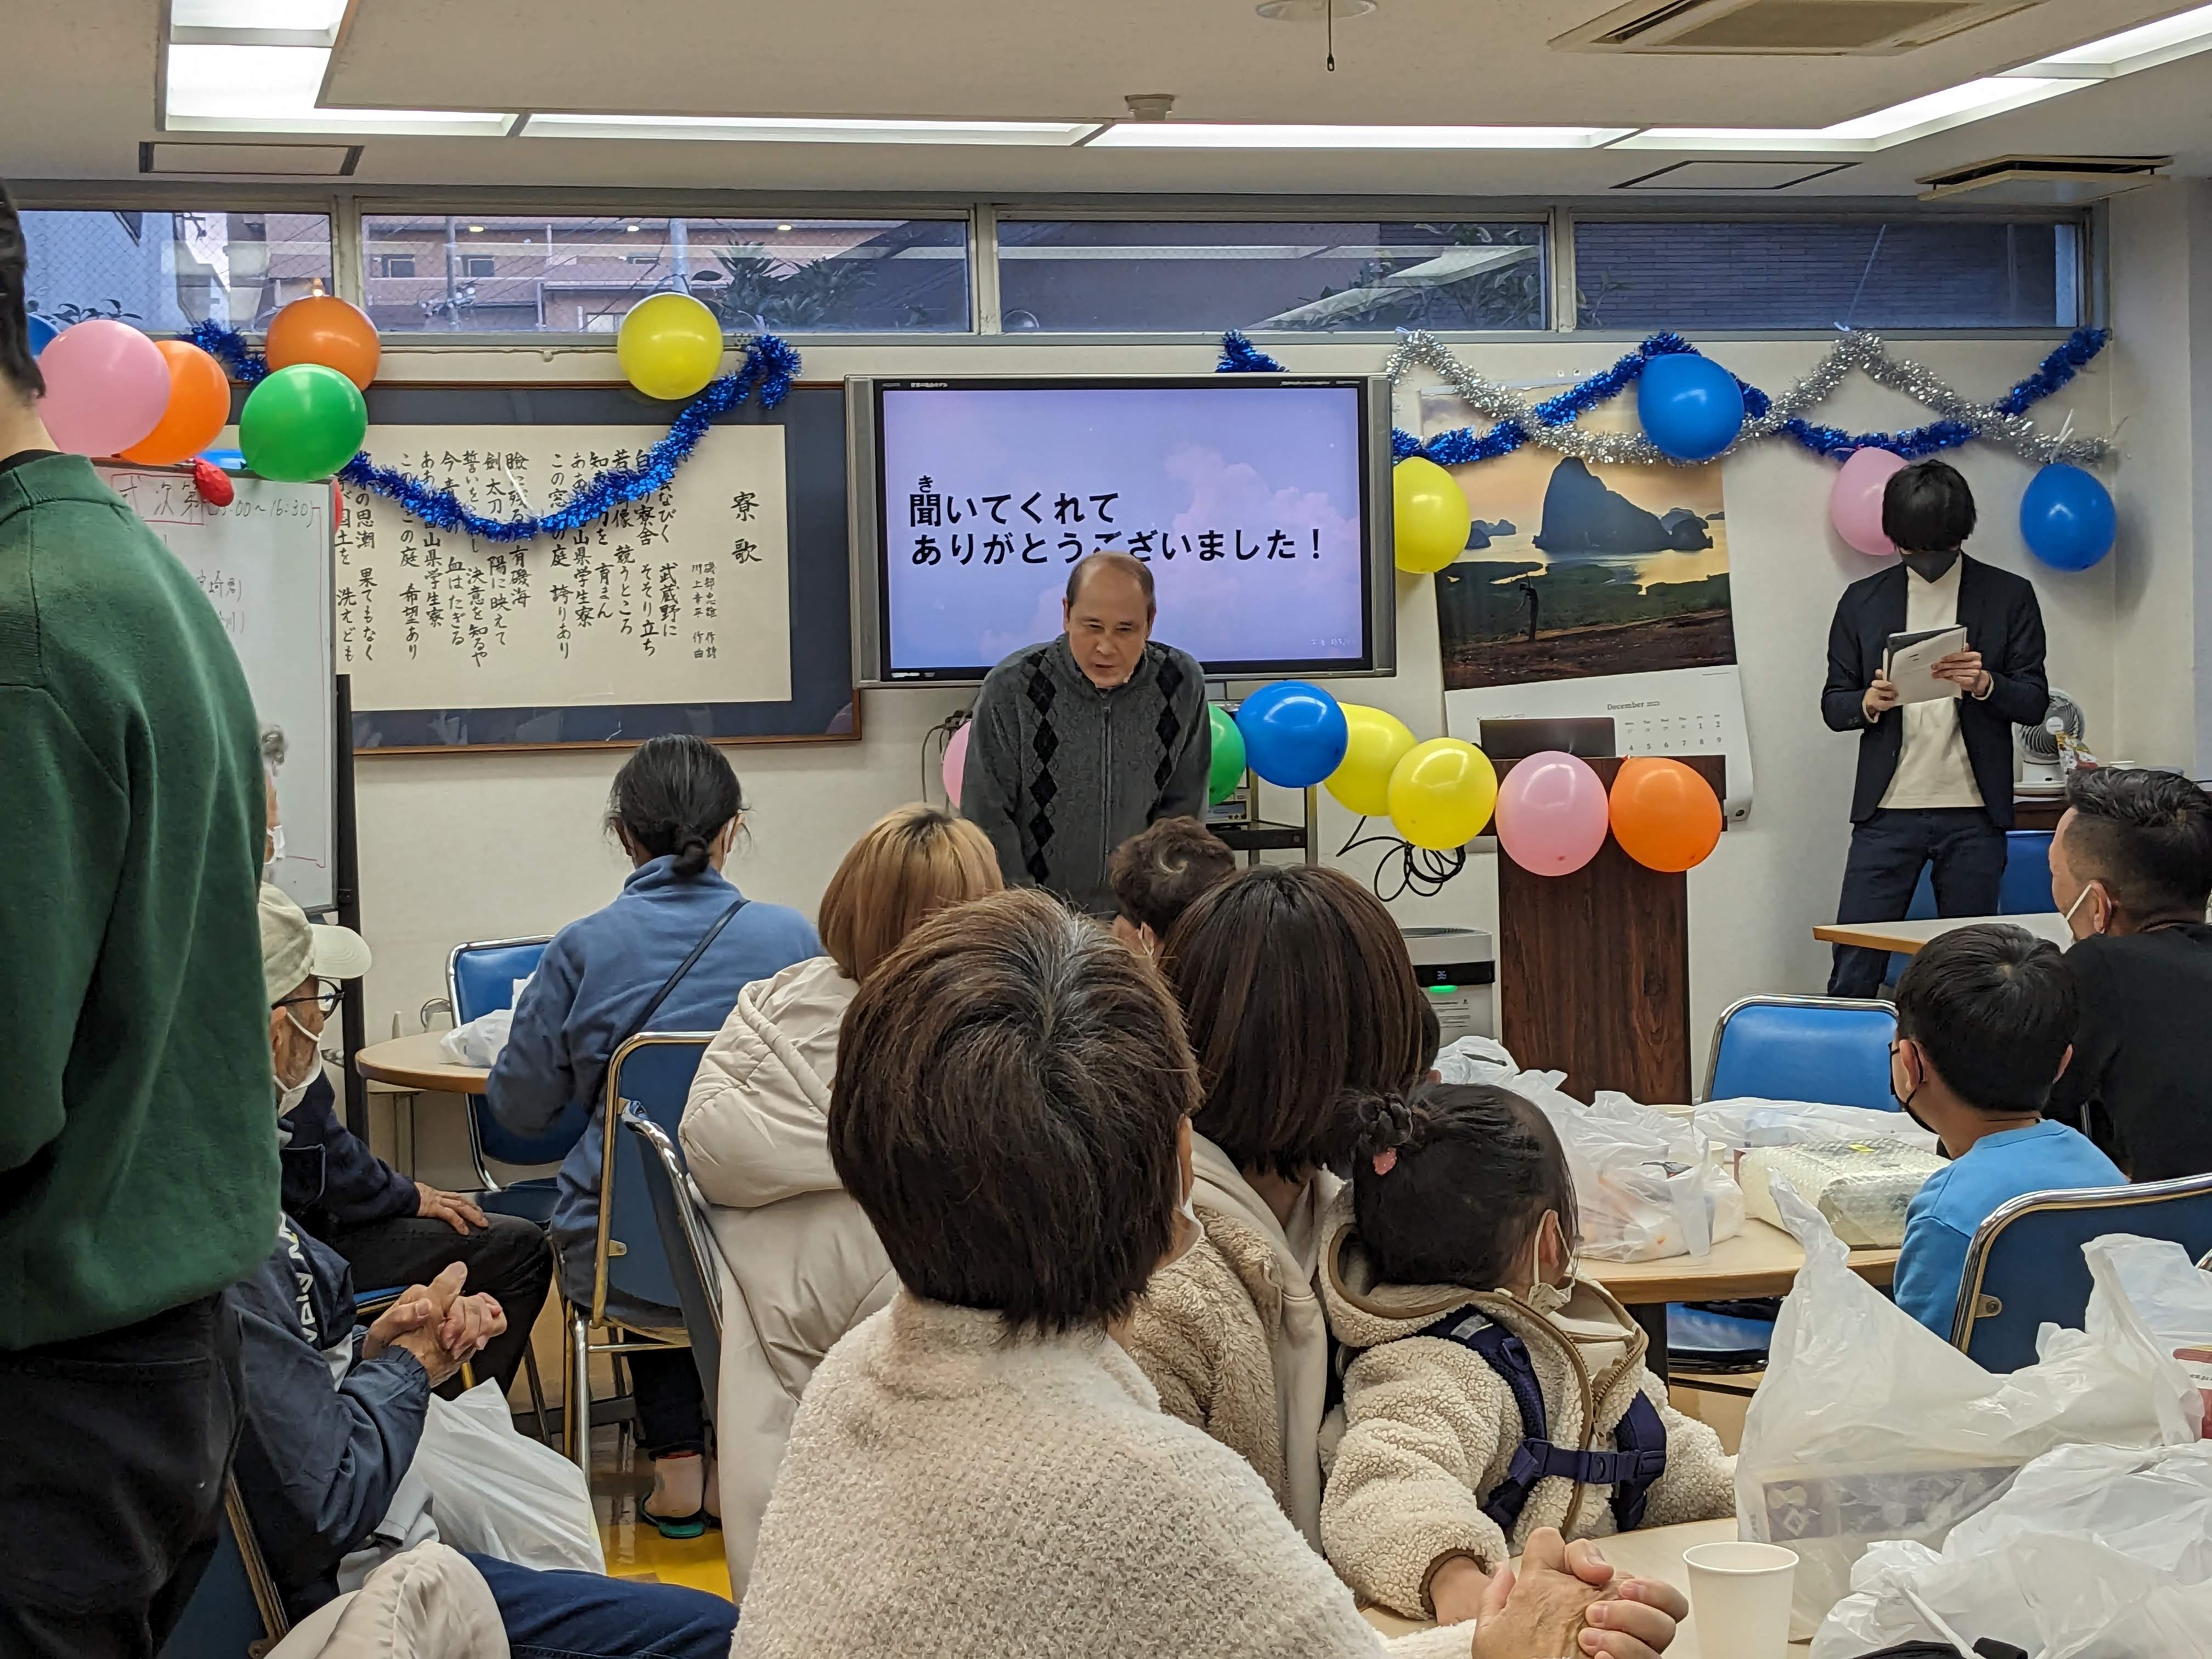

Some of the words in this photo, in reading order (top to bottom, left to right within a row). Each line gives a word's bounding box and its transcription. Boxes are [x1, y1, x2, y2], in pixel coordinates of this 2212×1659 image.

[356, 492, 376, 549] の思潮
[910, 492, 1120, 527] 聞いてくれて
[918, 475, 934, 493] き
[421, 451, 444, 628] ああ山県学生寮
[571, 452, 595, 628] ああ山県学生寮
[731, 491, 763, 565] 寮歌
[336, 586, 358, 662] 洗えども
[358, 567, 379, 661] 果てもなく
[399, 583, 422, 660] 希望あり
[445, 556, 467, 646] 血はたぎる
[487, 555, 511, 646] 陽に映えて
[614, 544, 636, 635] 競うところ
[640, 563, 659, 657] そそり立ち
[659, 562, 681, 637] 武蔵野に
